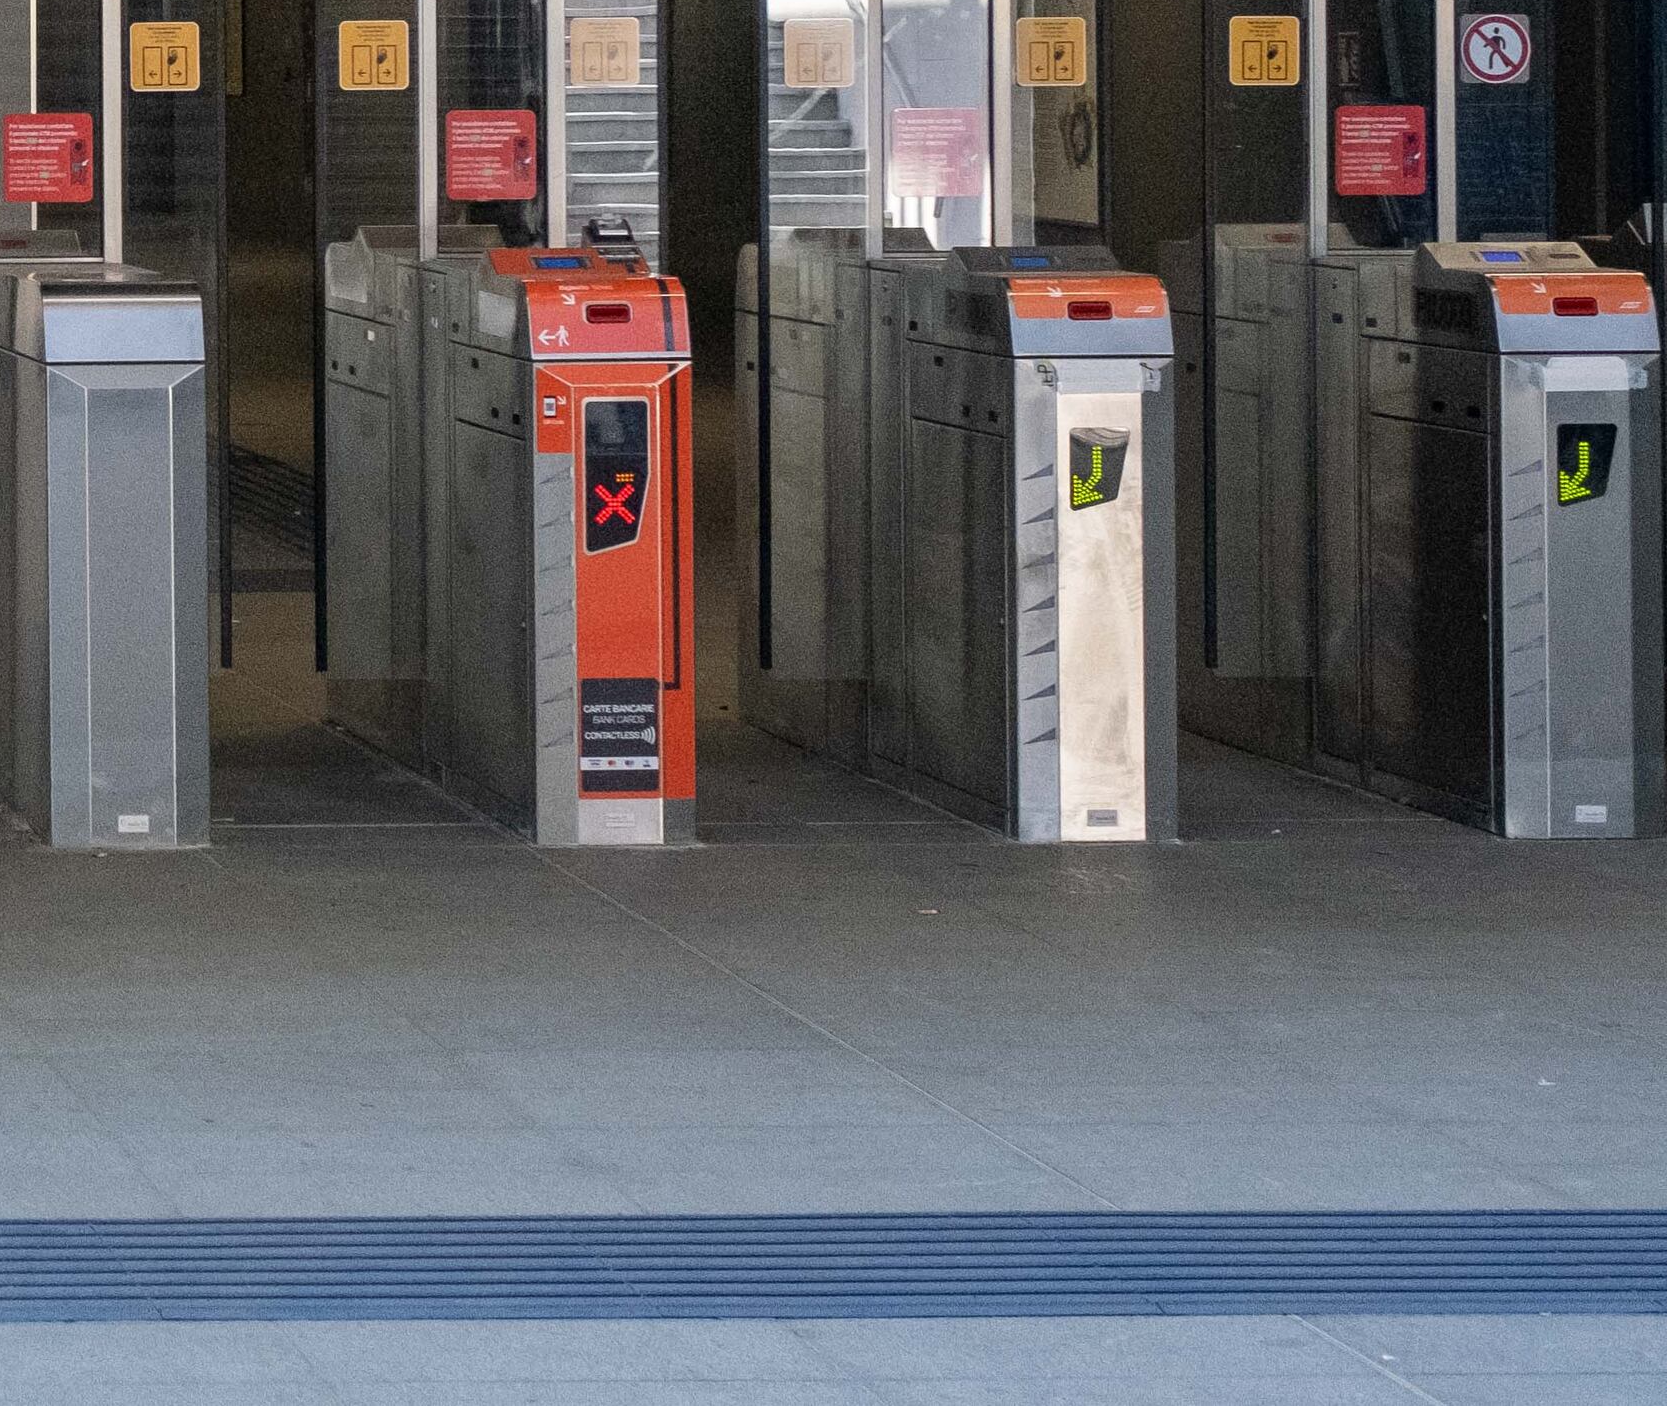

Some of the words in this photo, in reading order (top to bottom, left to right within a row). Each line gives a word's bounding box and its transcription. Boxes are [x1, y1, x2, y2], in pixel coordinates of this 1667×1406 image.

[583, 704, 611, 714] CARTE
[613, 704, 655, 714] BANCARIE
[592, 715, 615, 724] BANK
[617, 715, 646, 724] CARDS
[584, 730, 641, 741] CONTACTLESS
